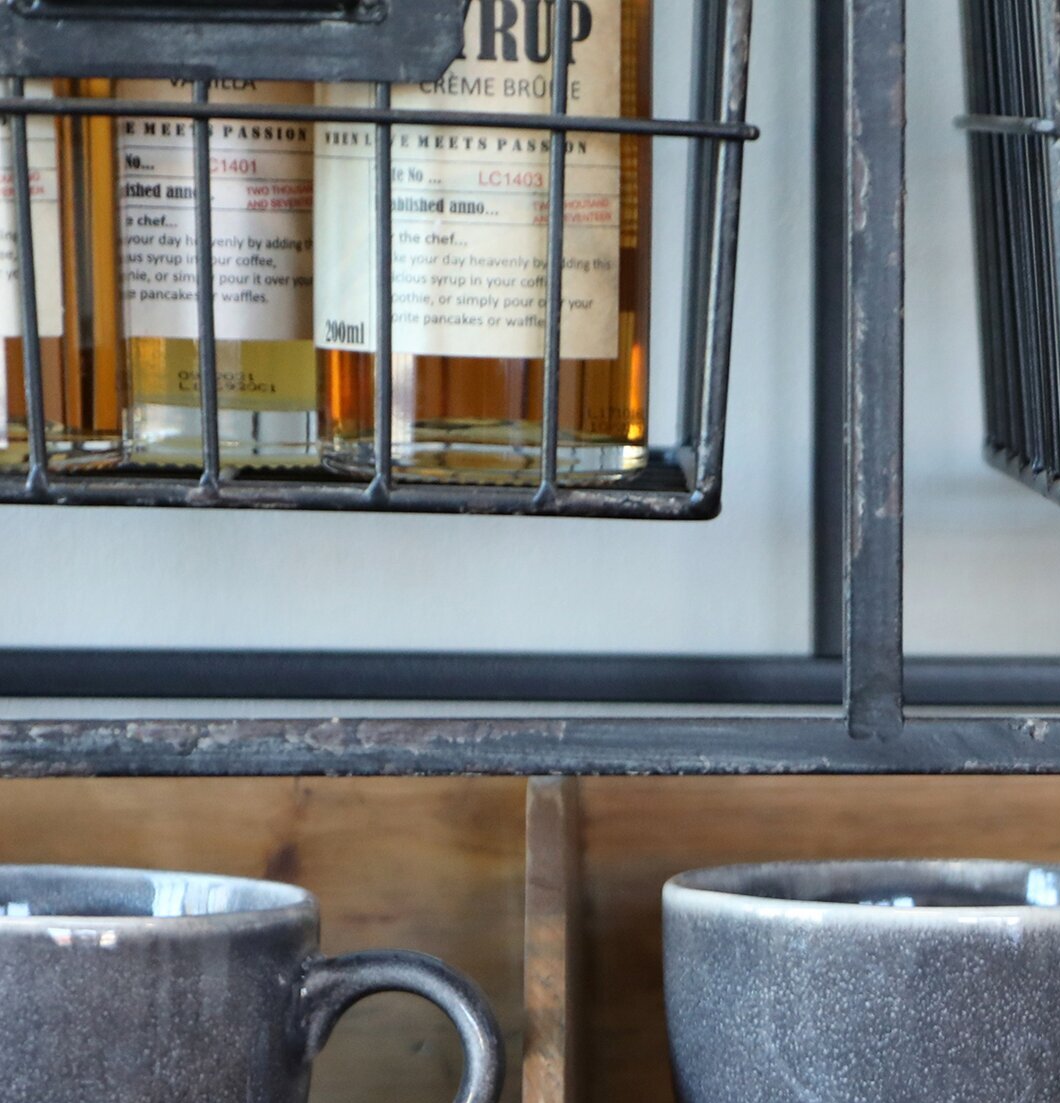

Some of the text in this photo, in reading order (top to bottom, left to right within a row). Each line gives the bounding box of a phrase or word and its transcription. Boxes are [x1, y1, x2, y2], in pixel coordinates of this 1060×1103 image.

[455, 0, 592, 65] RUP
[419, 72, 581, 100] CRÈME BRÛE
[144, 121, 213, 138] MEE
[223, 125, 307, 142] PASSION
[418, 135, 487, 151] MEETS
[498, 138, 587, 155] PASSON
[209, 158, 257, 174] C1401
[408, 166, 423, 182] No
[478, 170, 544, 189] LC1403
[449, 200, 499, 216] anno...
[137, 214, 178, 228] chef...
[158, 233, 182, 248] day
[247, 236, 262, 250] by
[265, 237, 303, 253] adding
[399, 231, 420, 244] the
[424, 232, 468, 246] chef...
[146, 253, 183, 266] syrup
[235, 254, 277, 269] coffee,
[410, 256, 439, 267] your
[442, 254, 465, 268] day
[469, 255, 529, 270] heavenly
[154, 271, 169, 281] or
[219, 273, 250, 286] pour
[252, 273, 261, 285] it
[264, 275, 290, 287] over
[430, 275, 466, 287] syrup
[470, 275, 482, 286] in
[487, 276, 516, 289] your
[222, 289, 269, 304] waffles.
[438, 294, 452, 305] or
[456, 293, 499, 309] simply
[504, 297, 534, 309] pour
[568, 298, 593, 311] your
[423, 313, 483, 326] pancakes
[487, 316, 501, 326] or
[505, 315, 547, 328] waffle
[325, 319, 365, 345] 200ml
